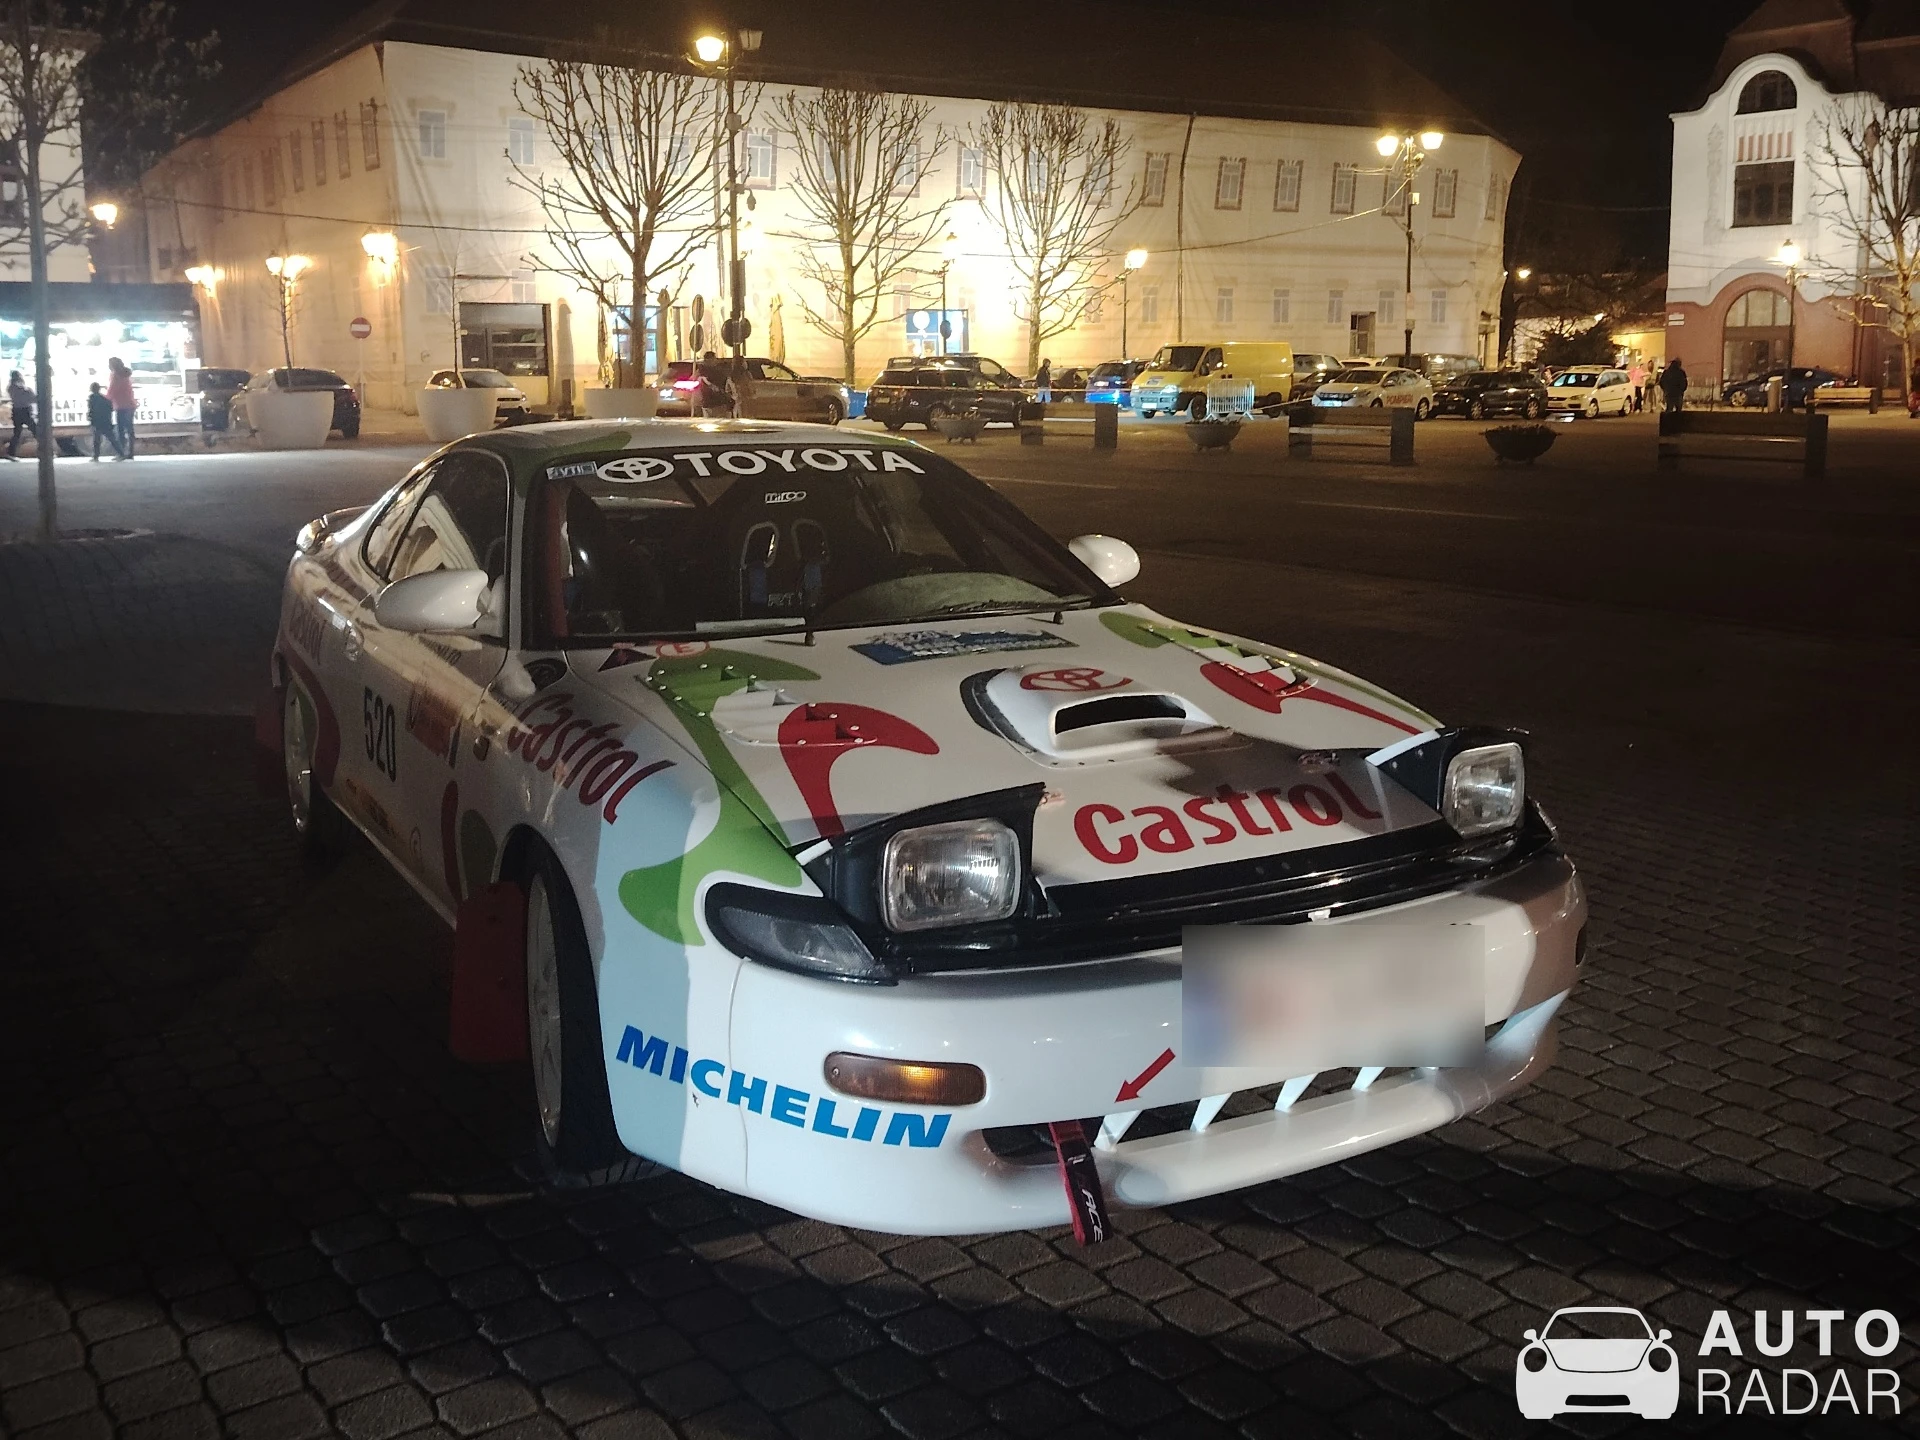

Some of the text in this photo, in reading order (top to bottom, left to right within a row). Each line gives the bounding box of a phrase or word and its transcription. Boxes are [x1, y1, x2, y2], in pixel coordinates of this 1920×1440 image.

[673, 448, 926, 477] TOYOTA
[363, 685, 397, 783] 520
[507, 693, 677, 824] Castrol
[1073, 772, 1383, 864] Castrol
[615, 1024, 953, 1148] MICHELIN
